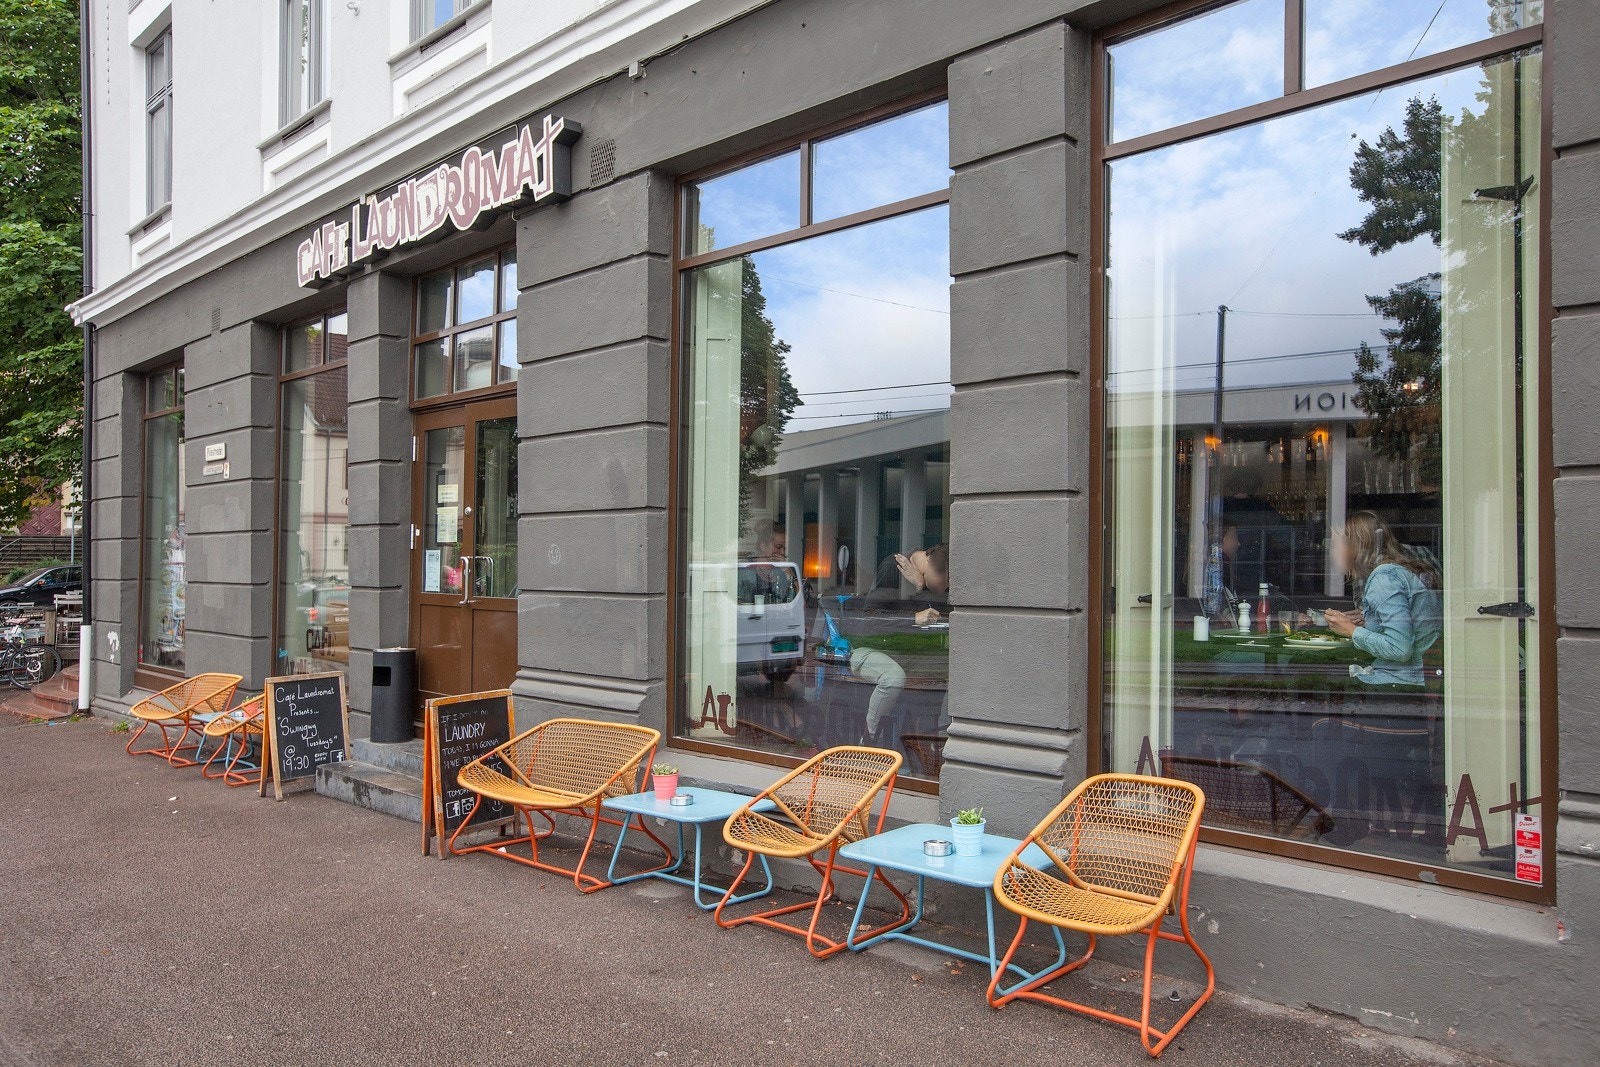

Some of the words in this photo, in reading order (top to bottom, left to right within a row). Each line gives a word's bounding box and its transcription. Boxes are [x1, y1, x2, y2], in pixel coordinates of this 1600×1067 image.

[352, 114, 565, 262] LAUNDROMAT
[276, 687, 295, 704] Café
[298, 685, 335, 700] Laundromat
[445, 722, 486, 742] LAUNDRY
